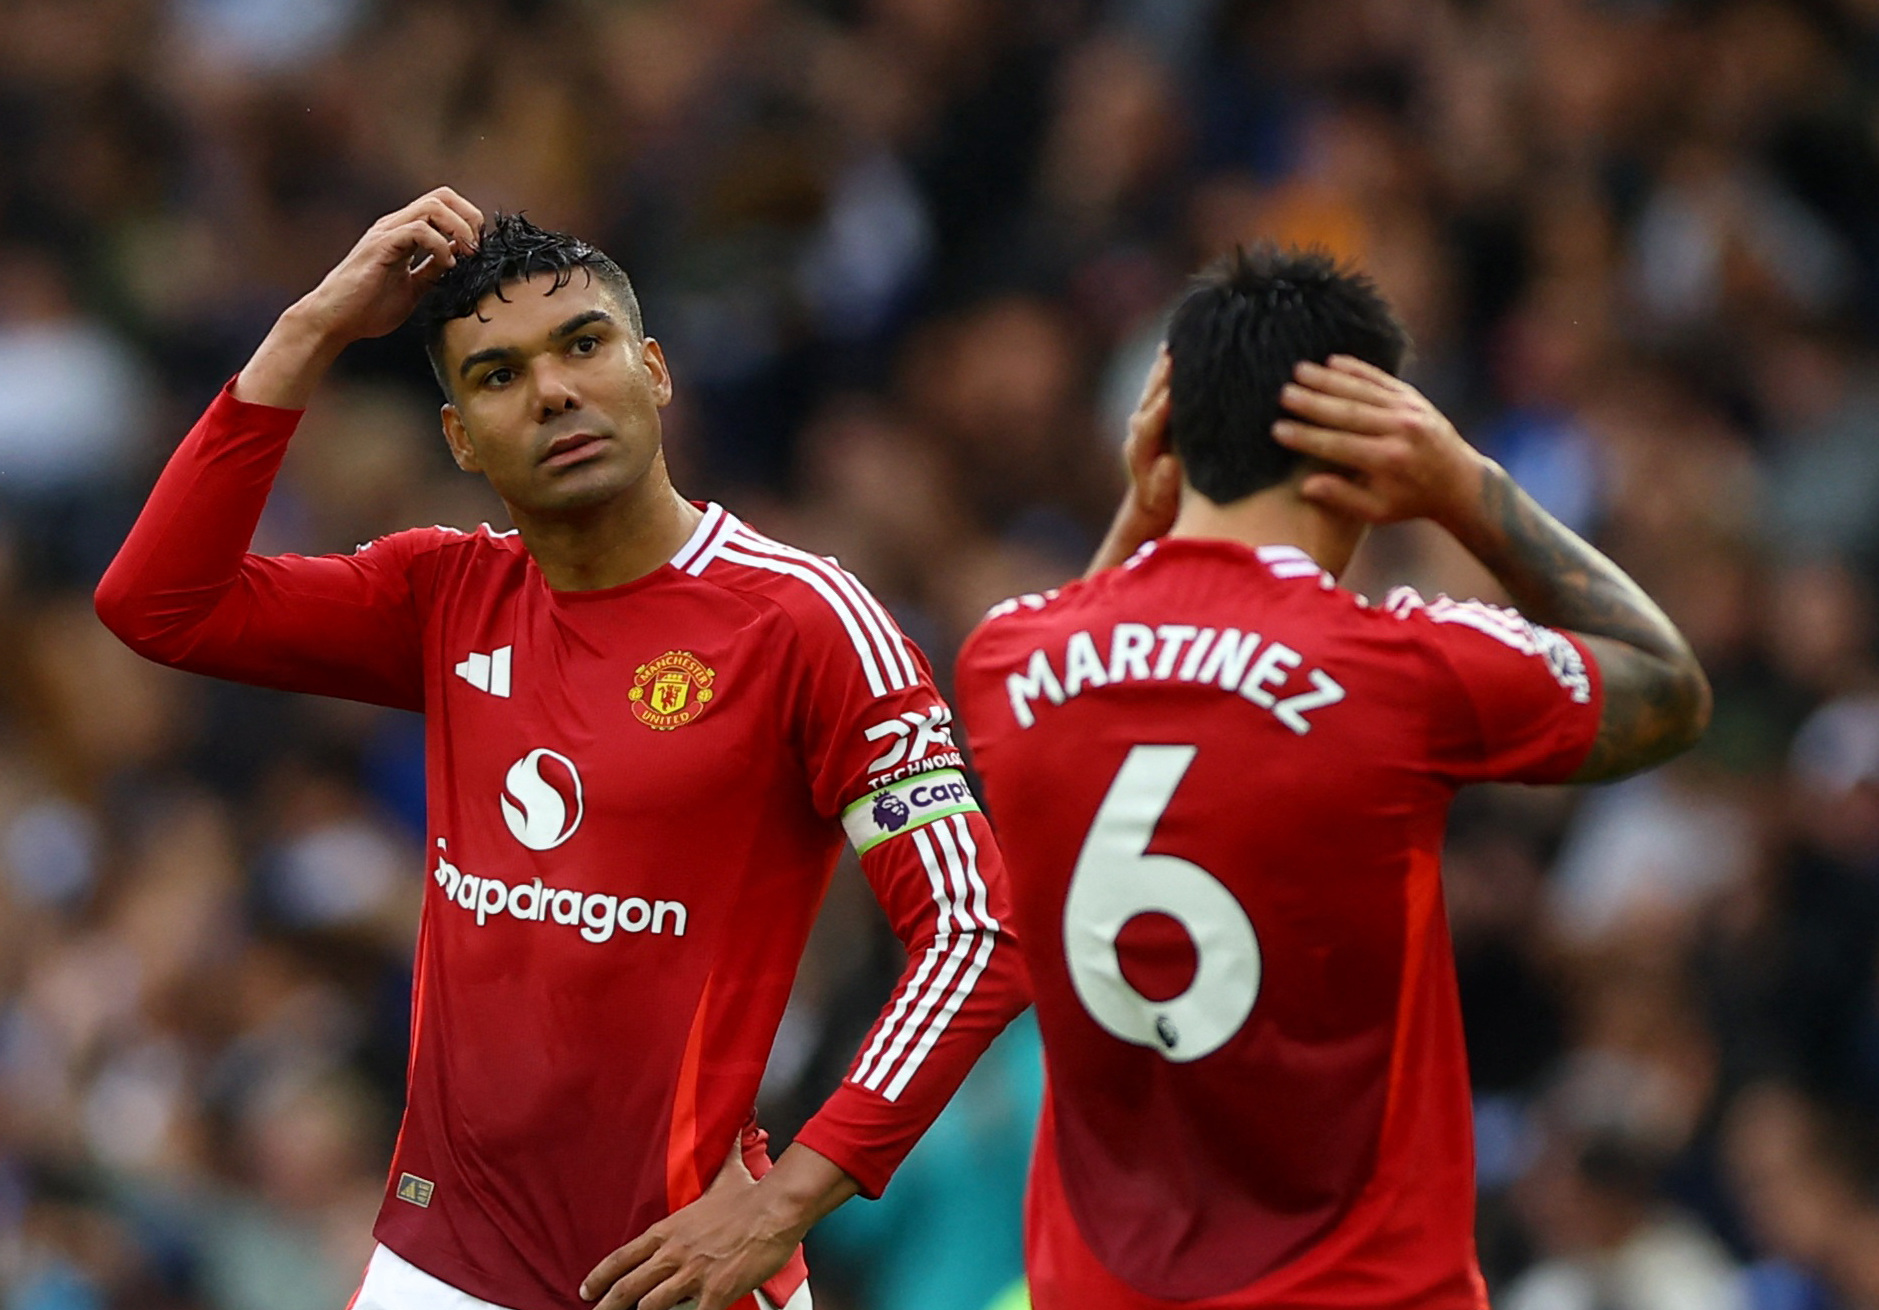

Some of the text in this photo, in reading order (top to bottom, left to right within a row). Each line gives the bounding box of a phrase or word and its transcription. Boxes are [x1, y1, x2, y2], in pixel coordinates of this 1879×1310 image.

[640, 656, 708, 684] MANCHESTER
[1006, 623, 1346, 735] MARTINEZ
[641, 710, 690, 725] UNITED
[1062, 745, 1263, 1063] 6
